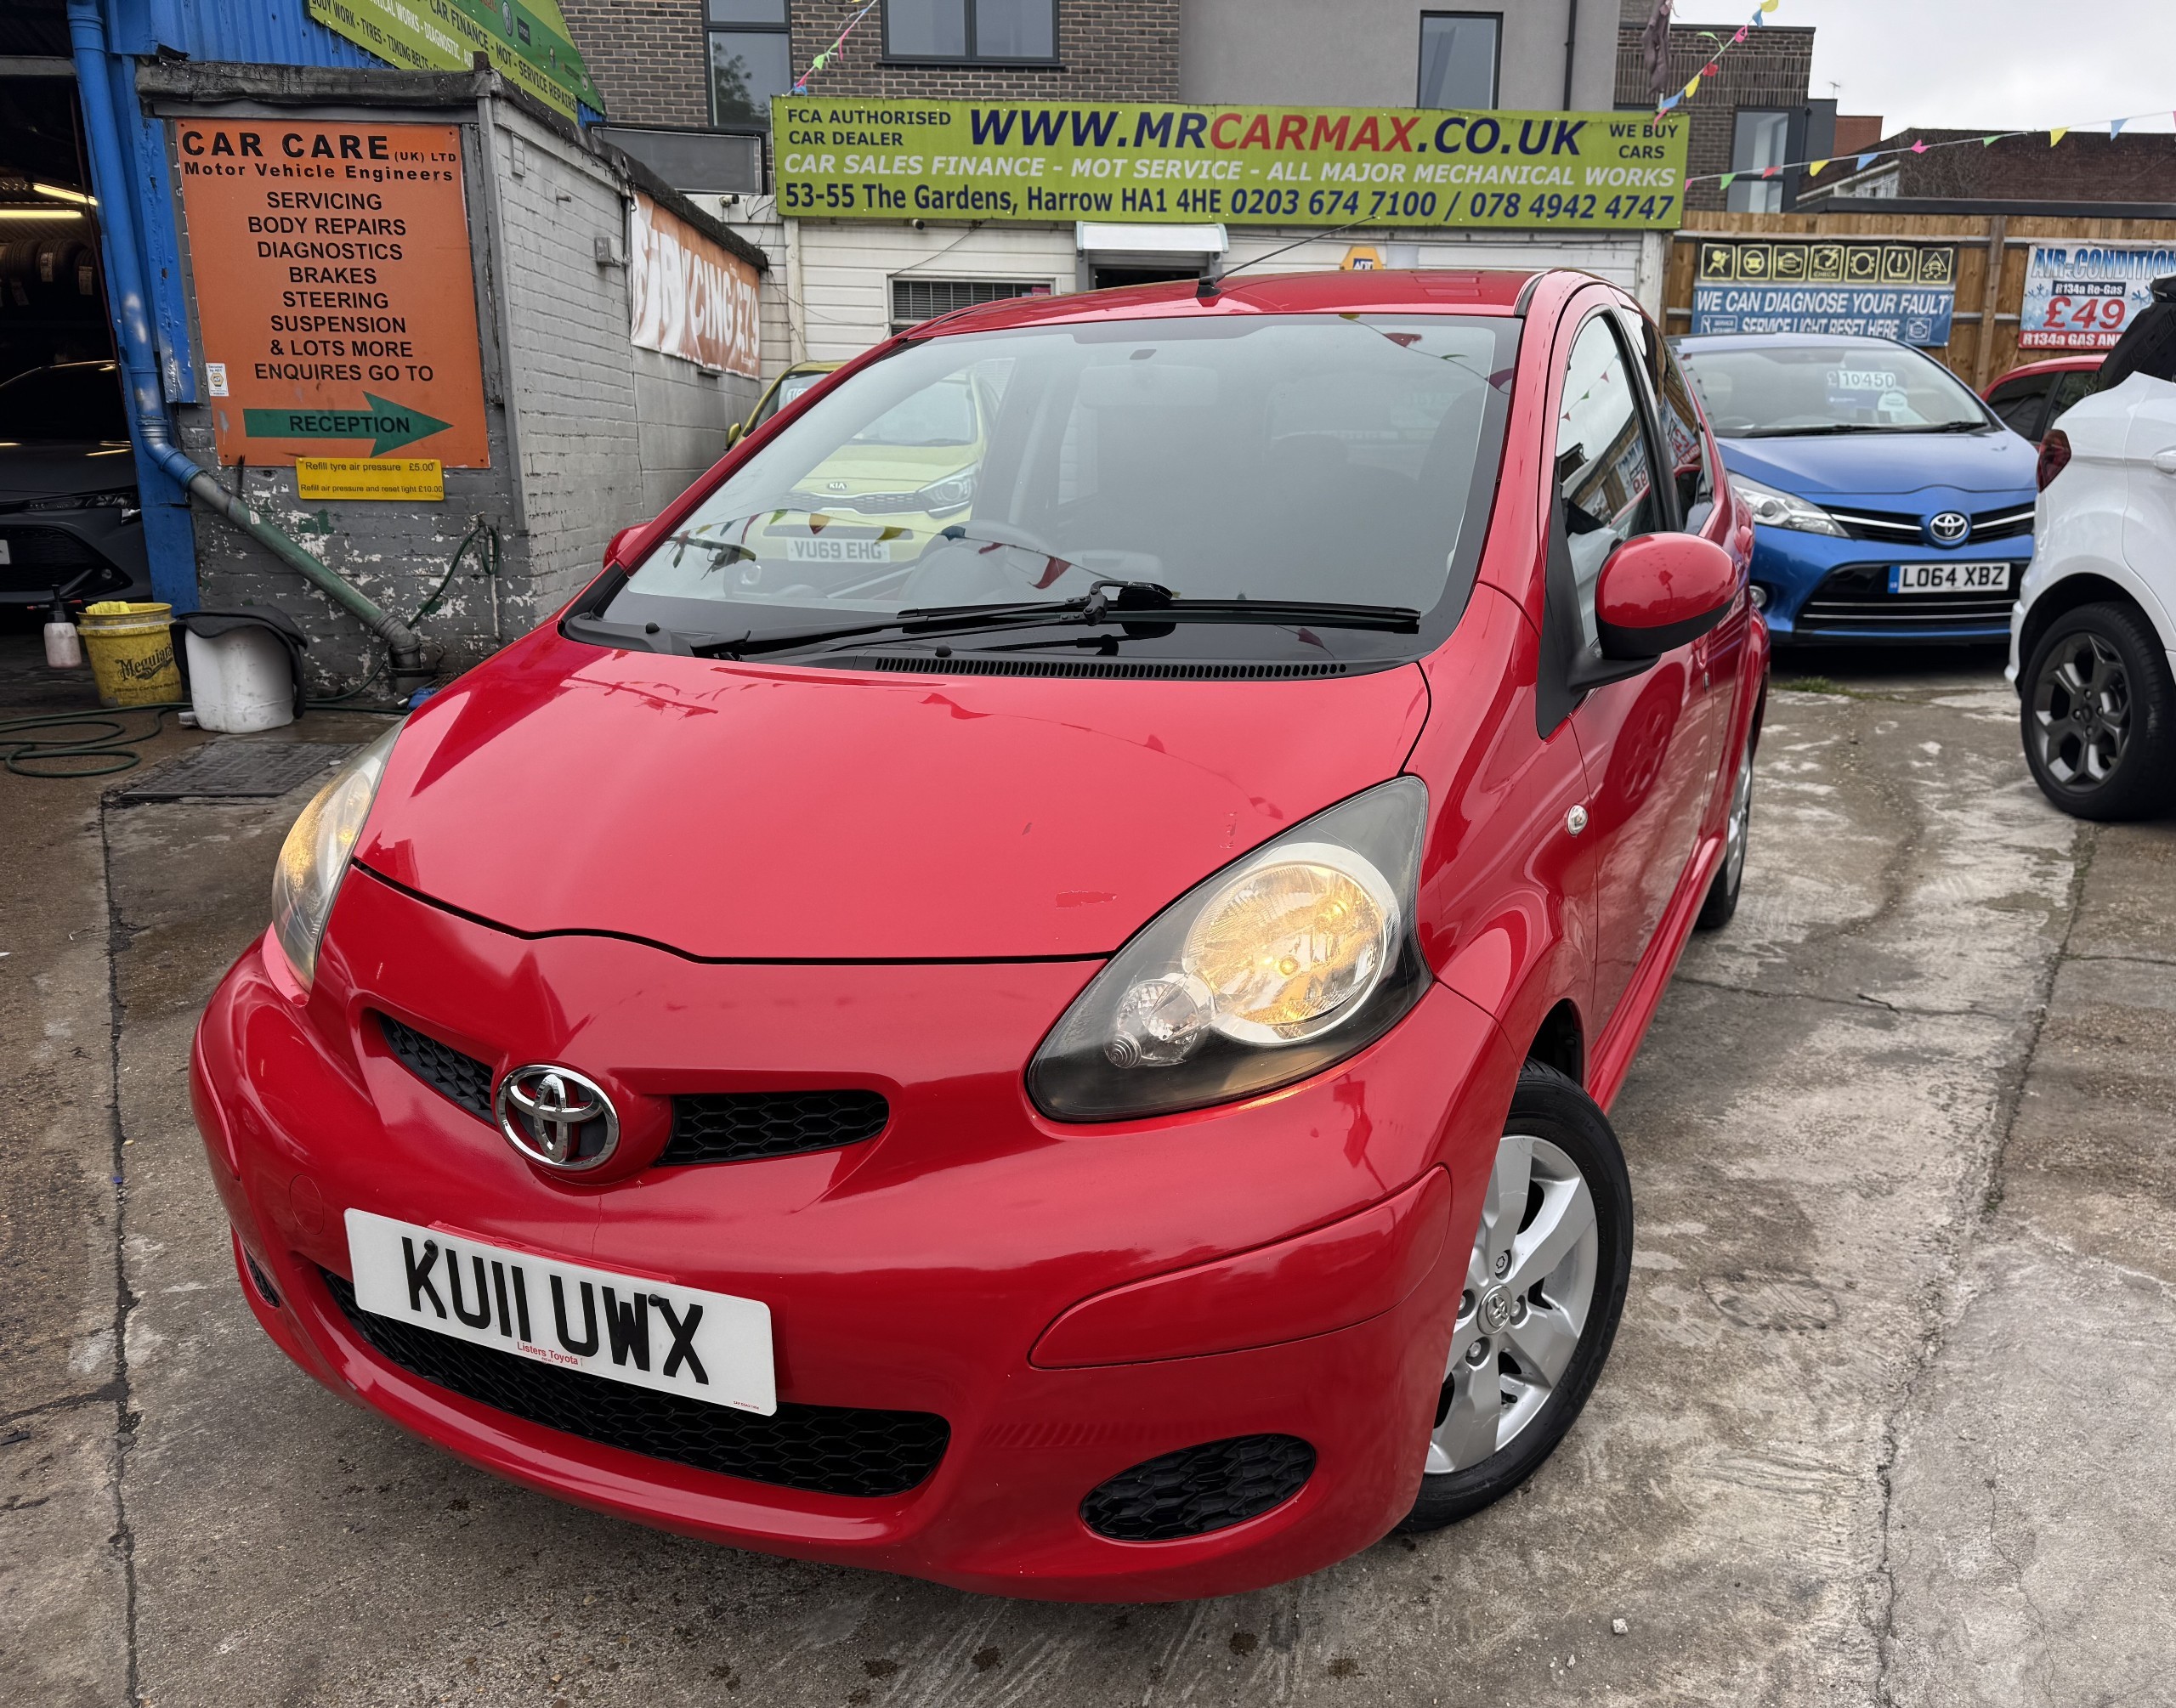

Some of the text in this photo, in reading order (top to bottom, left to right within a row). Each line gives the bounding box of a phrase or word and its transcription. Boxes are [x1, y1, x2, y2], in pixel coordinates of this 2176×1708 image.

[396, 3, 420, 33] WORKS
[333, 0, 355, 29] WORK
[360, 17, 382, 44] TYRES
[387, 33, 411, 62] TIMING
[411, 48, 429, 70] BELTS
[429, 0, 449, 23] CAR
[450, 8, 489, 51] FINANCE
[496, 42, 512, 68] MOT
[518, 59, 548, 94] SERVICE
[548, 82, 577, 114] REPAIRS
[788, 109, 951, 126] FCA AUTHORISED
[789, 131, 904, 146] CAR DEALER
[971, 108, 1588, 156] WWW.MRCARMAX.CO.UK
[1609, 124, 1679, 139] WE BUY
[182, 131, 456, 163] CAR CARE (UK) LTD
[1618, 144, 1665, 159] CARS
[184, 161, 453, 183] Motor Vehicle Engineers
[785, 153, 836, 174] CAR
[843, 155, 924, 175] SALES
[932, 156, 1045, 177] FINANCE
[1071, 158, 1128, 178] MOT
[1132, 159, 1242, 180] SERVICE
[1266, 161, 1312, 181] ALL
[1321, 162, 1409, 184] MAJOR
[1414, 164, 1573, 185] MECHANICAL
[1585, 167, 1675, 187] WORKS
[266, 191, 382, 211] SERVICING
[785, 182, 855, 208] 53-55
[862, 184, 907, 209] The
[914, 184, 1018, 215] Gardens,
[1027, 186, 1113, 212] Harrow
[1121, 187, 1168, 212] HA1
[1176, 187, 1222, 213] 4HE
[1231, 188, 1299, 215] 0203
[1308, 189, 1359, 215] 674
[1368, 190, 1436, 217] 7100
[1470, 192, 1521, 218] 078
[1529, 193, 1596, 219] 4942
[1604, 194, 1674, 220] 4747
[248, 216, 406, 236] BODY REPAIRS
[257, 240, 403, 261] DIAGNOSTICS
[289, 266, 377, 285] BRAKES
[282, 291, 389, 309] STEERING
[2055, 284, 2123, 296] R134a Re-Gas
[1697, 291, 1950, 314] WE CAN DIAGNOSE YOUR FAULT
[2043, 297, 2126, 330] £49
[270, 315, 406, 334] SUSPENSION
[1742, 317, 1900, 340] SERVICE LIGHT RESET HERE
[270, 340, 413, 358] & LOTS MORE
[2023, 333, 2066, 346] R134a
[2068, 334, 2096, 346] GAS
[254, 363, 434, 382] ENQUIRES GO TO
[289, 416, 411, 433] RECEPTION
[305, 461, 434, 472] Refill tyre air pressure £5.00
[794, 540, 882, 560] VU69 EHG
[1902, 566, 2004, 587] LO64 XBZ
[401, 1236, 711, 1385] KU11 UWX
[517, 1342, 579, 1366] Listers Toyota
